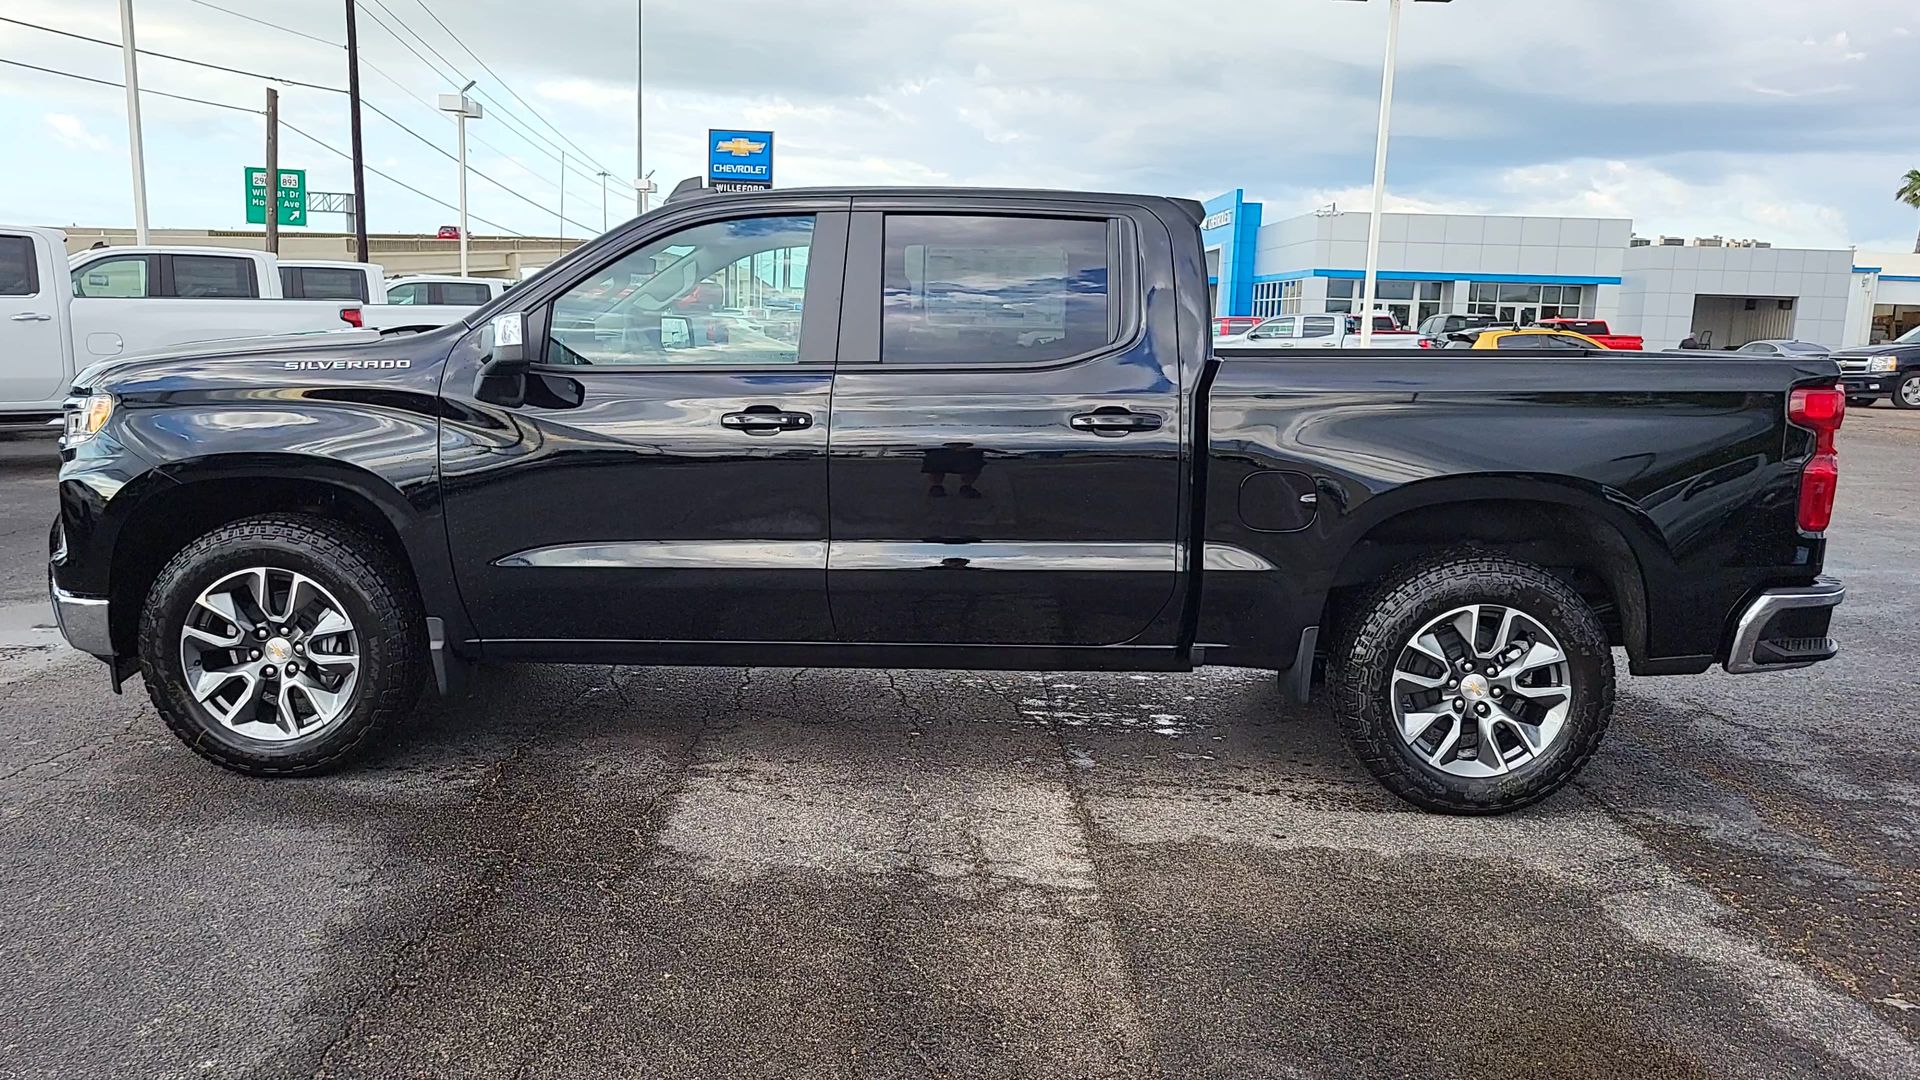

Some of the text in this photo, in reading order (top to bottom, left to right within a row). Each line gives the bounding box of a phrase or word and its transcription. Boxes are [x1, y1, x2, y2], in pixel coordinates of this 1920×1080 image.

[713, 164, 767, 174] CHEVROLET
[282, 178, 297, 187] 893
[289, 190, 300, 198] Dr
[284, 200, 300, 208] Ave
[284, 359, 411, 371] SILVERADO
